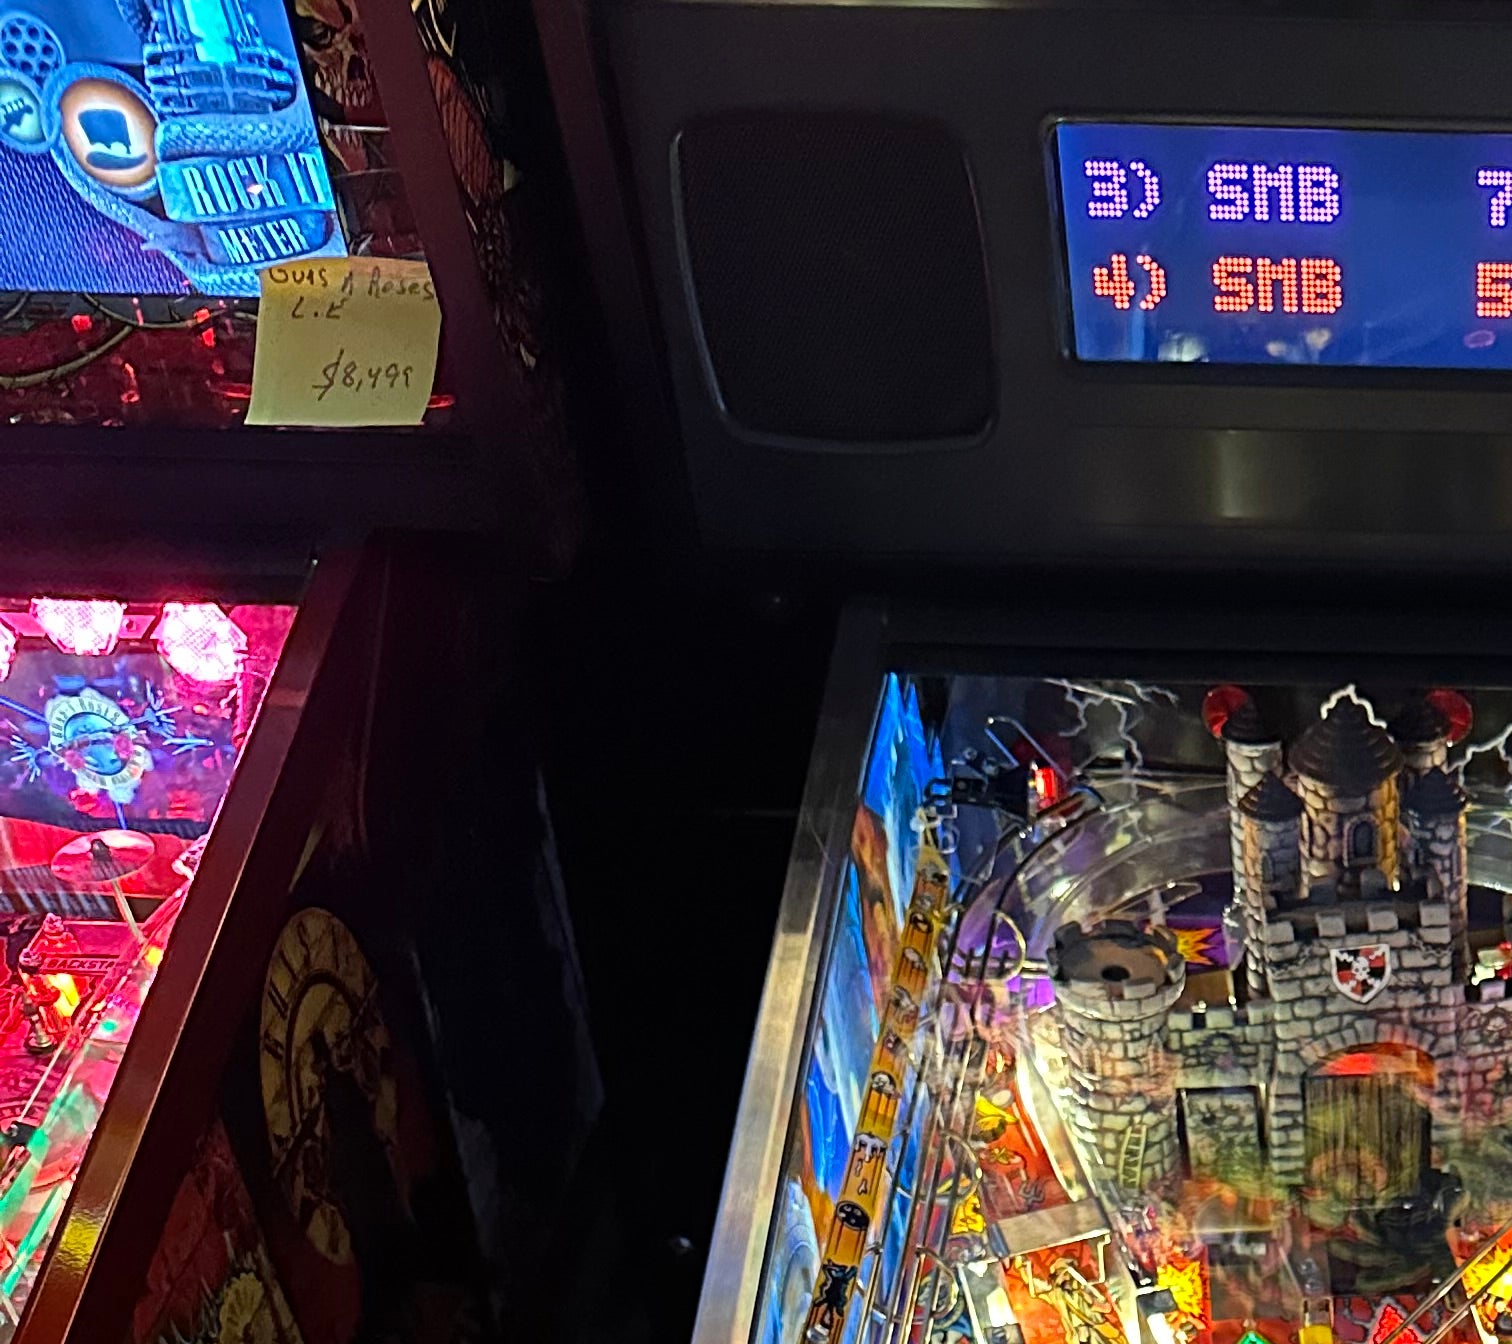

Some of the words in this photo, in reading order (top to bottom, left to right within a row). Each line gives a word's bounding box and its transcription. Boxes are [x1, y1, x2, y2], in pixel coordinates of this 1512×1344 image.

[183, 154, 286, 216] ROCK
[285, 153, 326, 204] IT
[1084, 159, 1161, 220] 3)
[1207, 163, 1342, 223] SMB
[218, 217, 309, 264] METER
[1092, 253, 1168, 312] 4)
[1211, 256, 1342, 315] SMB
[312, 349, 414, 401] $8,499
[48, 956, 128, 971] BACKSTA
